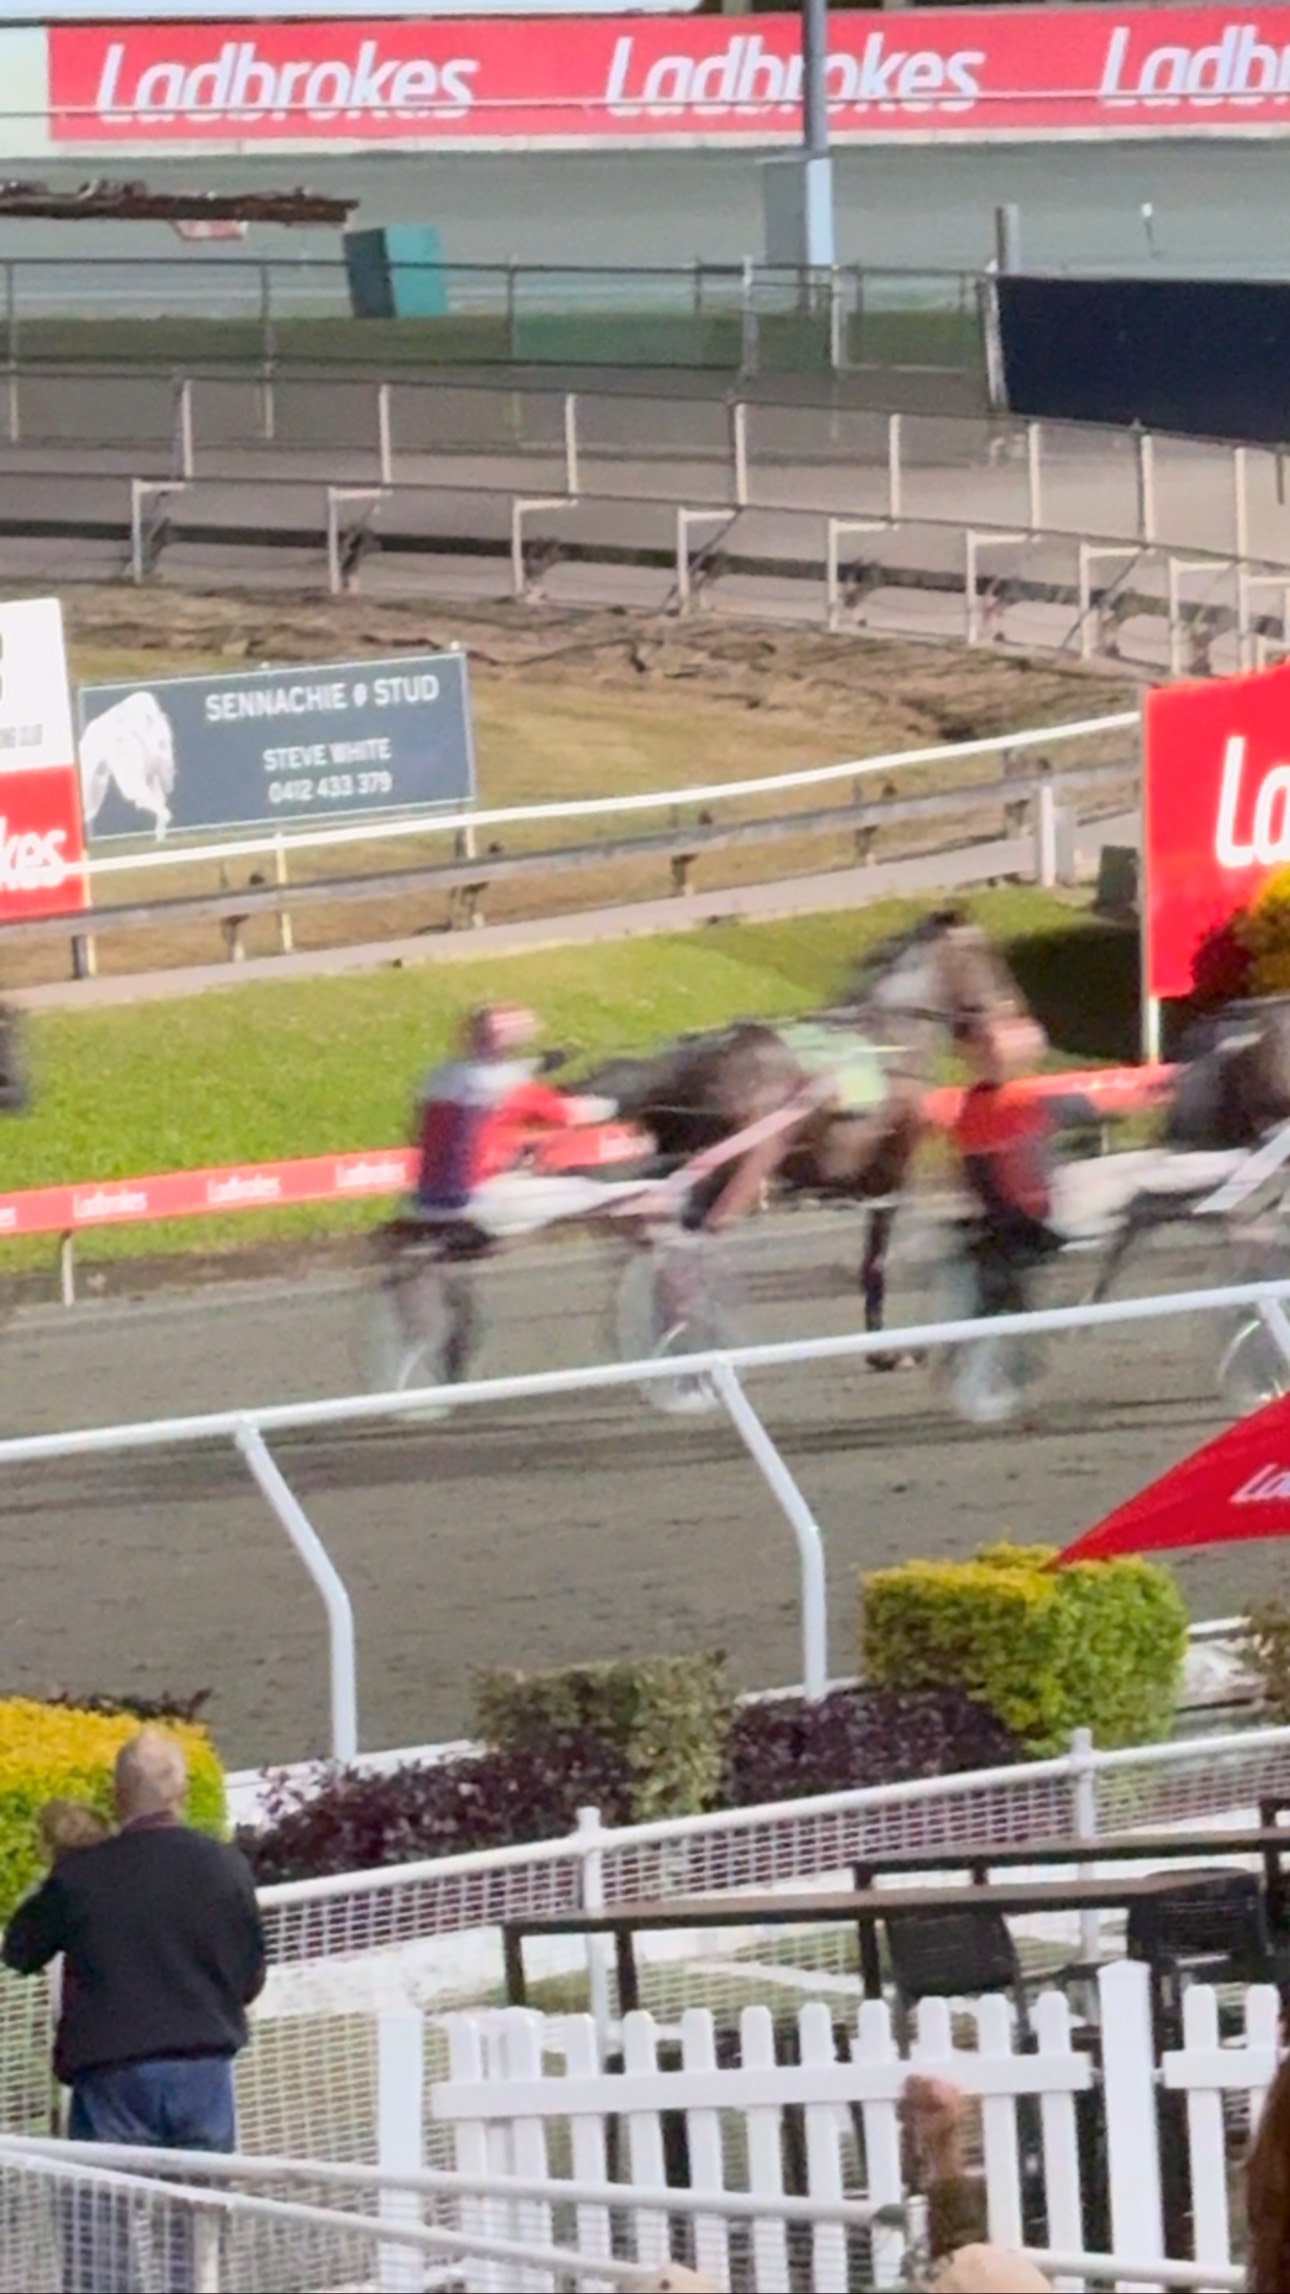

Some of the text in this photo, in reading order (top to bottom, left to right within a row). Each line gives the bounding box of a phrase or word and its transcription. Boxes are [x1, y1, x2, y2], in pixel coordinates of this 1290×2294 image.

[96, 40, 480, 124] Ladbrokes
[605, 31, 986, 116] Ladbrokes
[205, 683, 348, 721] SENNACHIE
[373, 674, 440, 705] STUD
[263, 737, 392, 771] STEVE WHITE
[268, 771, 393, 804] 0412 433 379
